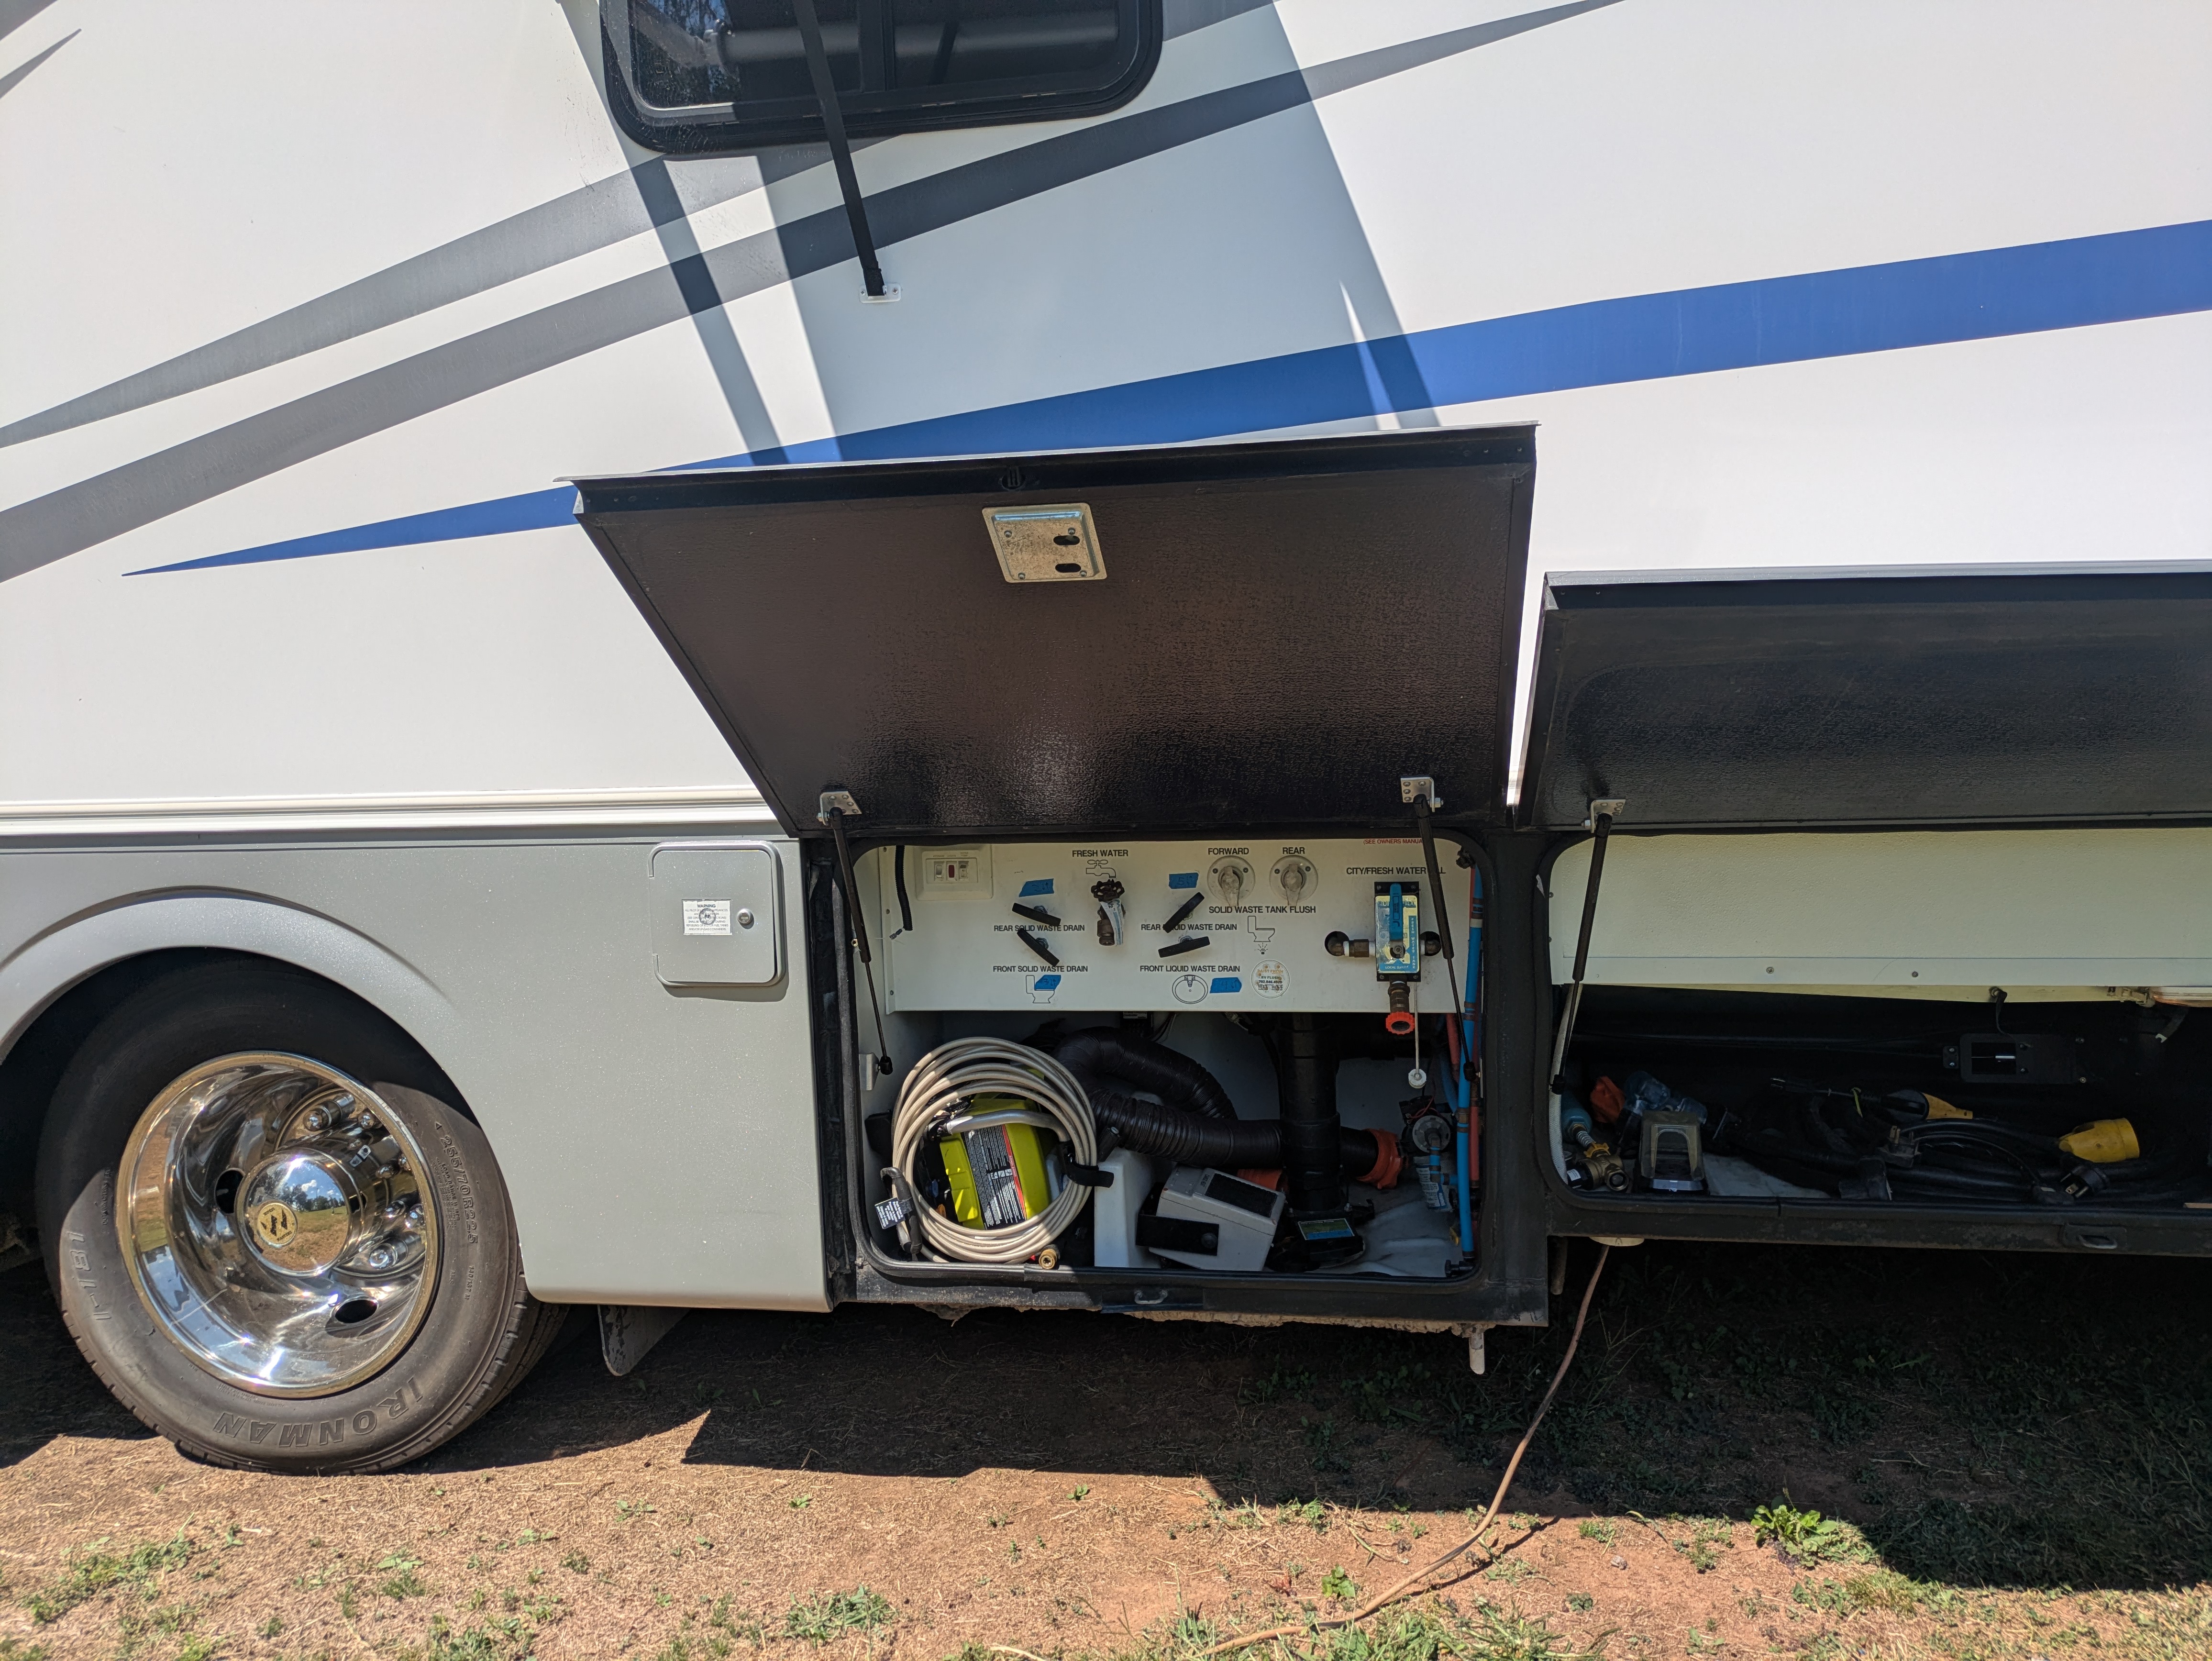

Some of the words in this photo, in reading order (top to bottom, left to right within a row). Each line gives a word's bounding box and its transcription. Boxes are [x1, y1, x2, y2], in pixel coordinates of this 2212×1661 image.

[1346, 867, 1394, 875] CITY/FRESH
[440, 1135, 478, 1244] 255/70R22.5
[441, 1163, 450, 1179] LOAD
[67, 1231, 112, 1320] I-181
[212, 1376, 423, 1448] IRONMAN
